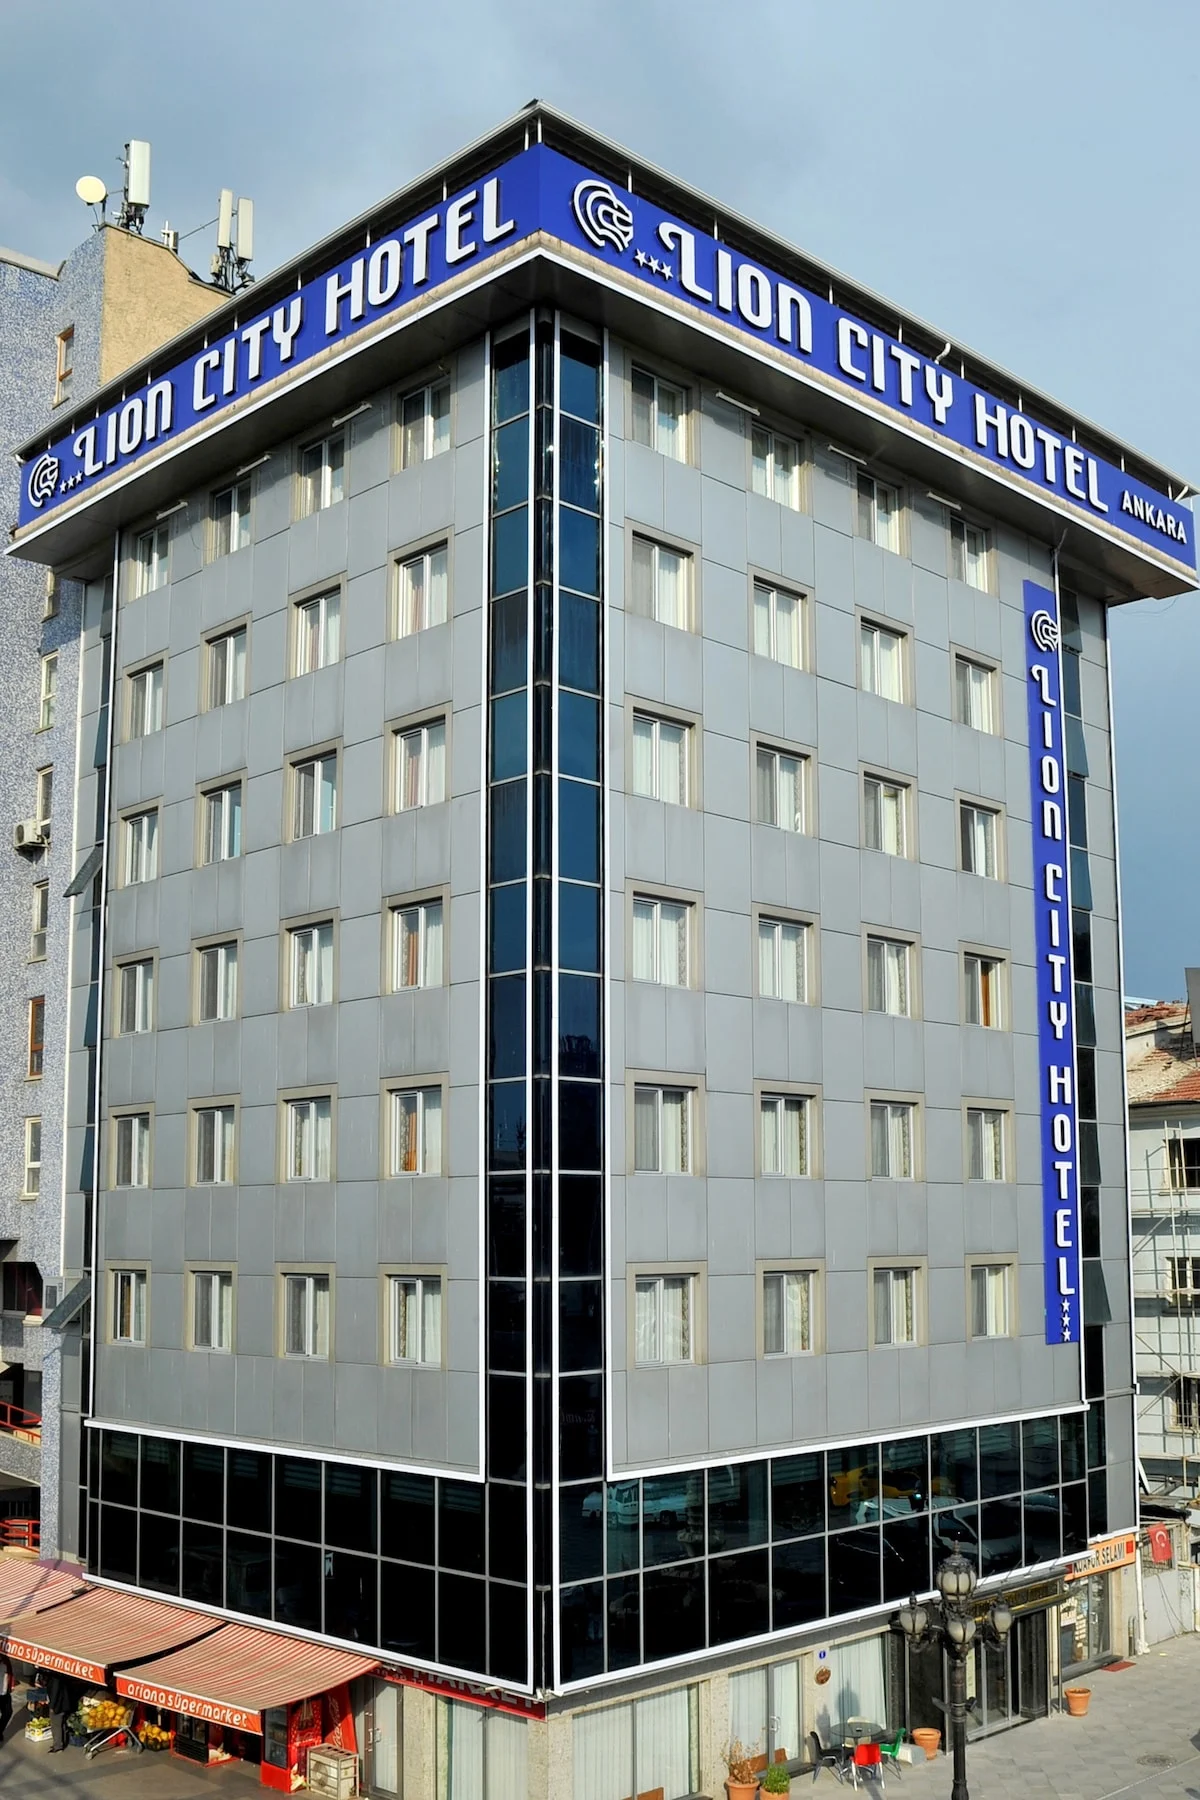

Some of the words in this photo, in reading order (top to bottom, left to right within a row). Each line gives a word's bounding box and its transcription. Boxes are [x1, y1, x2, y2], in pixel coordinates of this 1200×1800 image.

[73, 380, 172, 477] LION
[192, 297, 302, 412] CITY
[325, 177, 514, 335] HOTEL
[659, 222, 812, 354] LION
[838, 317, 954, 425] CITY
[975, 393, 1109, 513] HOTEL
[1122, 490, 1188, 544] ANKARA
[1031, 664, 1062, 840] LION
[1045, 863, 1067, 1040] CITY
[1049, 1065, 1076, 1296] HOTEL
[26, 1645, 95, 1679] süpermarket
[127, 1683, 166, 1704] ariana
[167, 1691, 248, 1728] süpermarket
